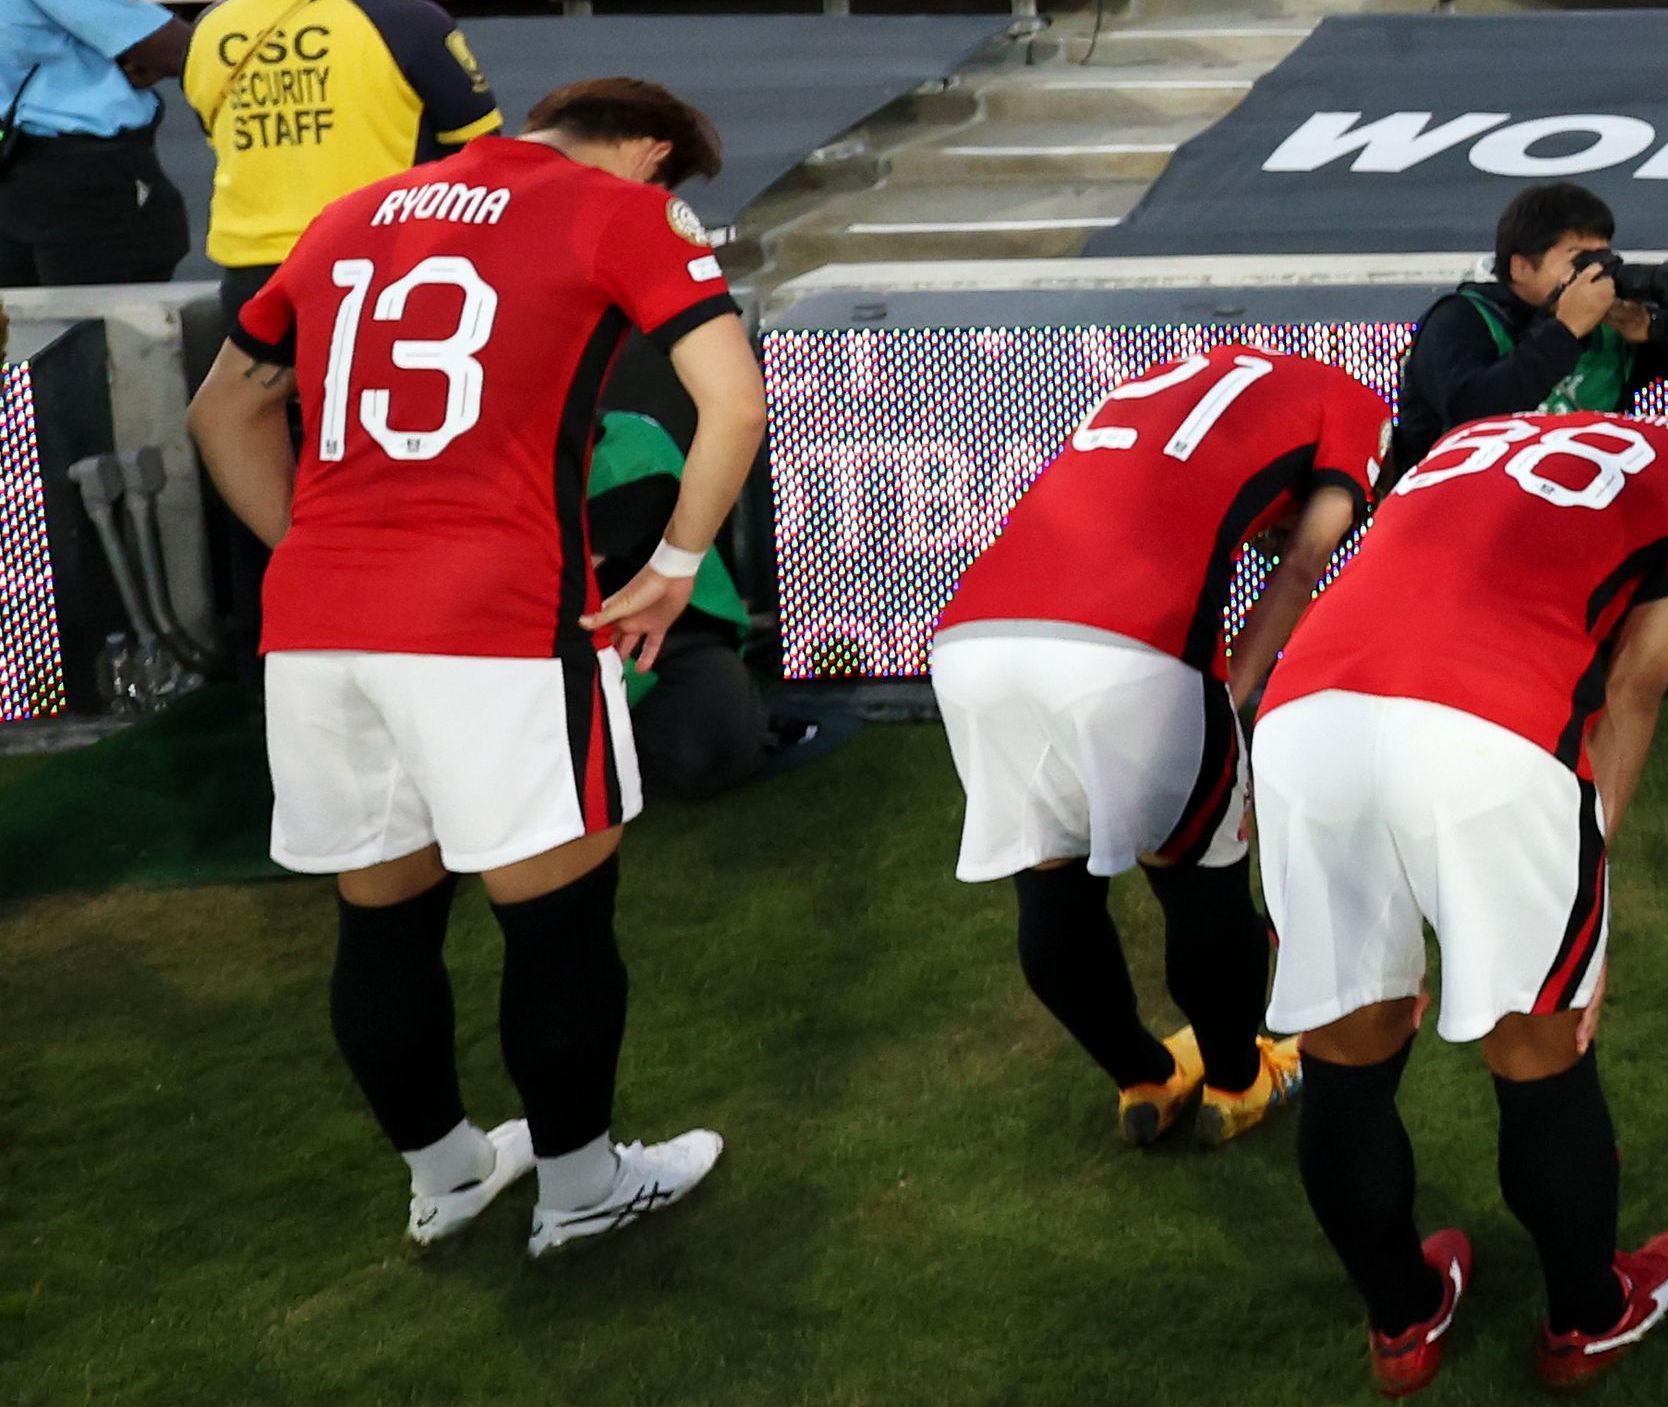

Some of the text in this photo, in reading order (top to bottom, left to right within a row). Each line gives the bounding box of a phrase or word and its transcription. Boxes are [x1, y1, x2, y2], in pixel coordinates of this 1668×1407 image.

[216, 23, 330, 67] CSC
[231, 108, 337, 152] STAFF
[371, 183, 512, 227] RYOMA
[319, 255, 499, 462] 13
[1069, 353, 1274, 462] 21
